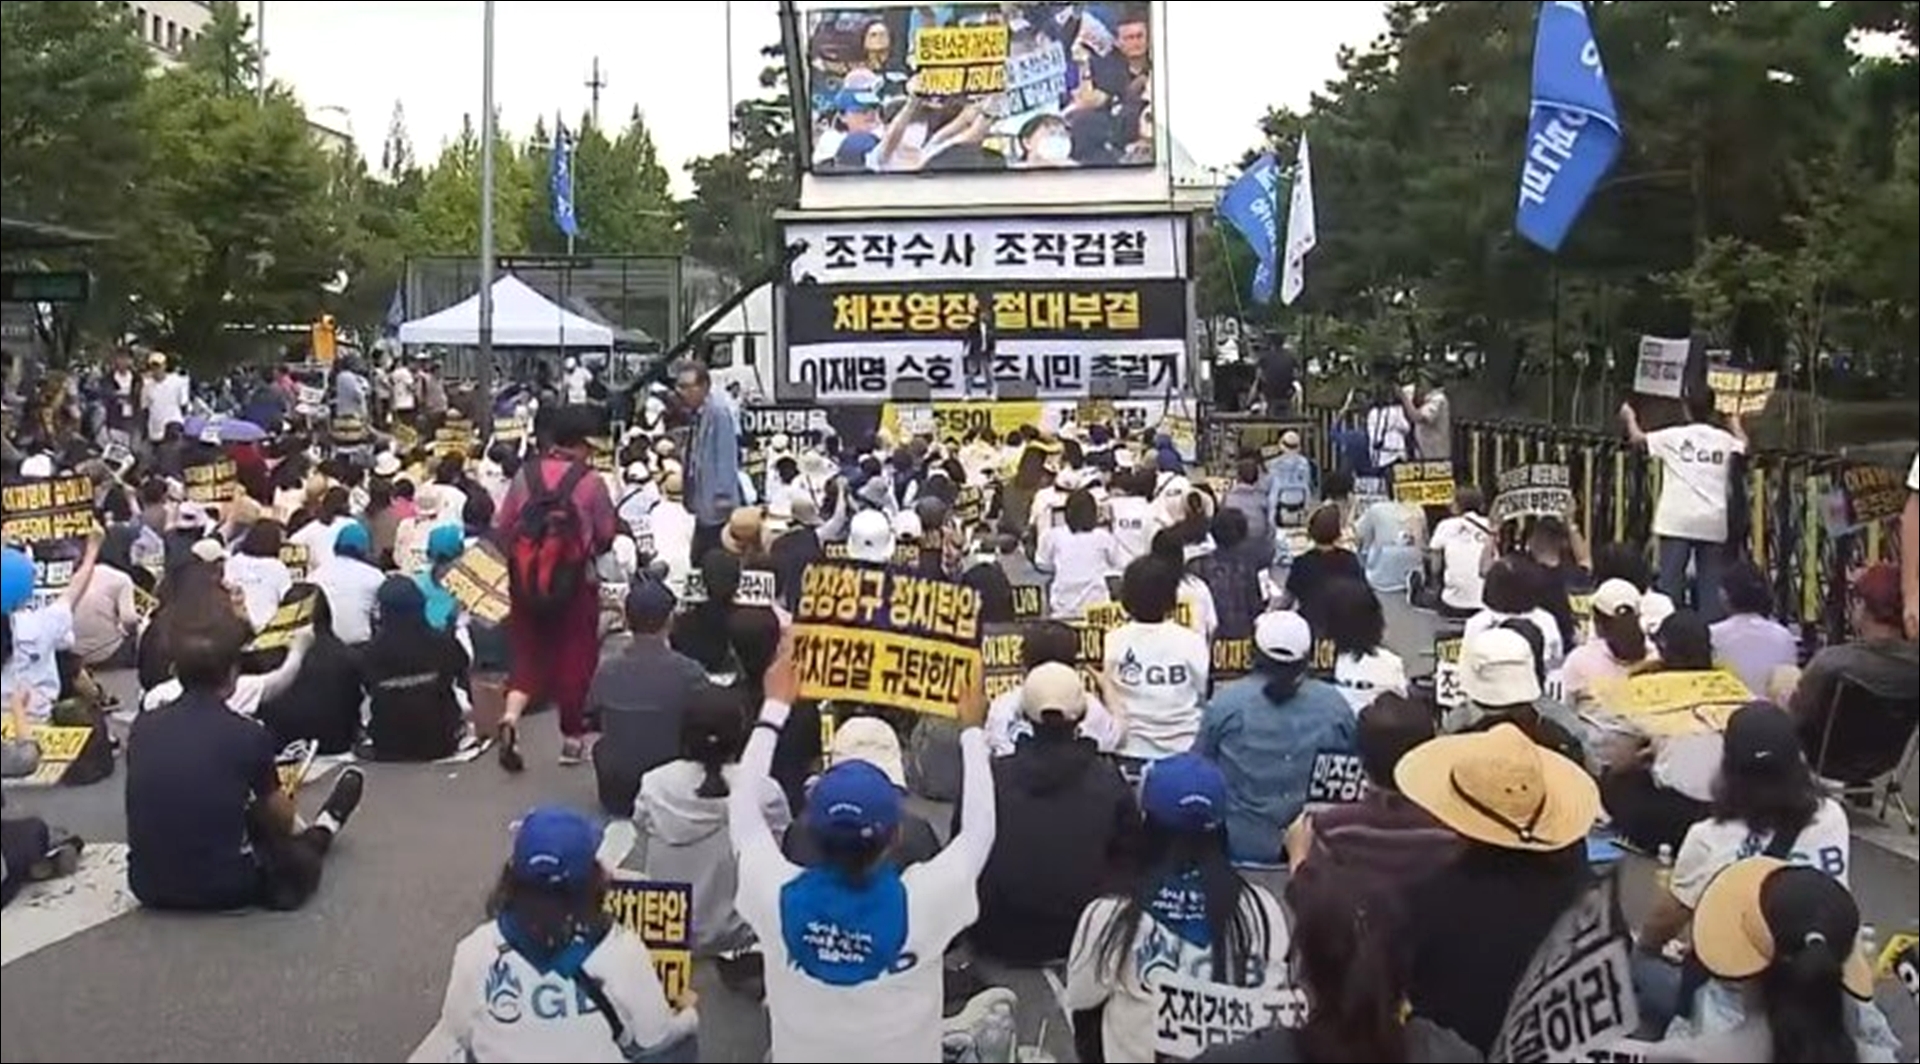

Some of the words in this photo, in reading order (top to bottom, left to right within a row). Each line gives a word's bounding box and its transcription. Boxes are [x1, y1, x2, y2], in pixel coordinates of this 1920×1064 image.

[824, 232, 976, 270] 조작수사
[994, 231, 1148, 268] 조작검찰
[833, 293, 978, 331] 체포영장
[992, 291, 1140, 330] 절대부결
[800, 357, 887, 394] 이재명
[800, 564, 886, 623] 영장청구
[889, 574, 982, 640] 정치탄압
[880, 644, 973, 704] 규탄한다
[1146, 664, 1187, 686] GB
[1311, 754, 1368, 800] 민주당
